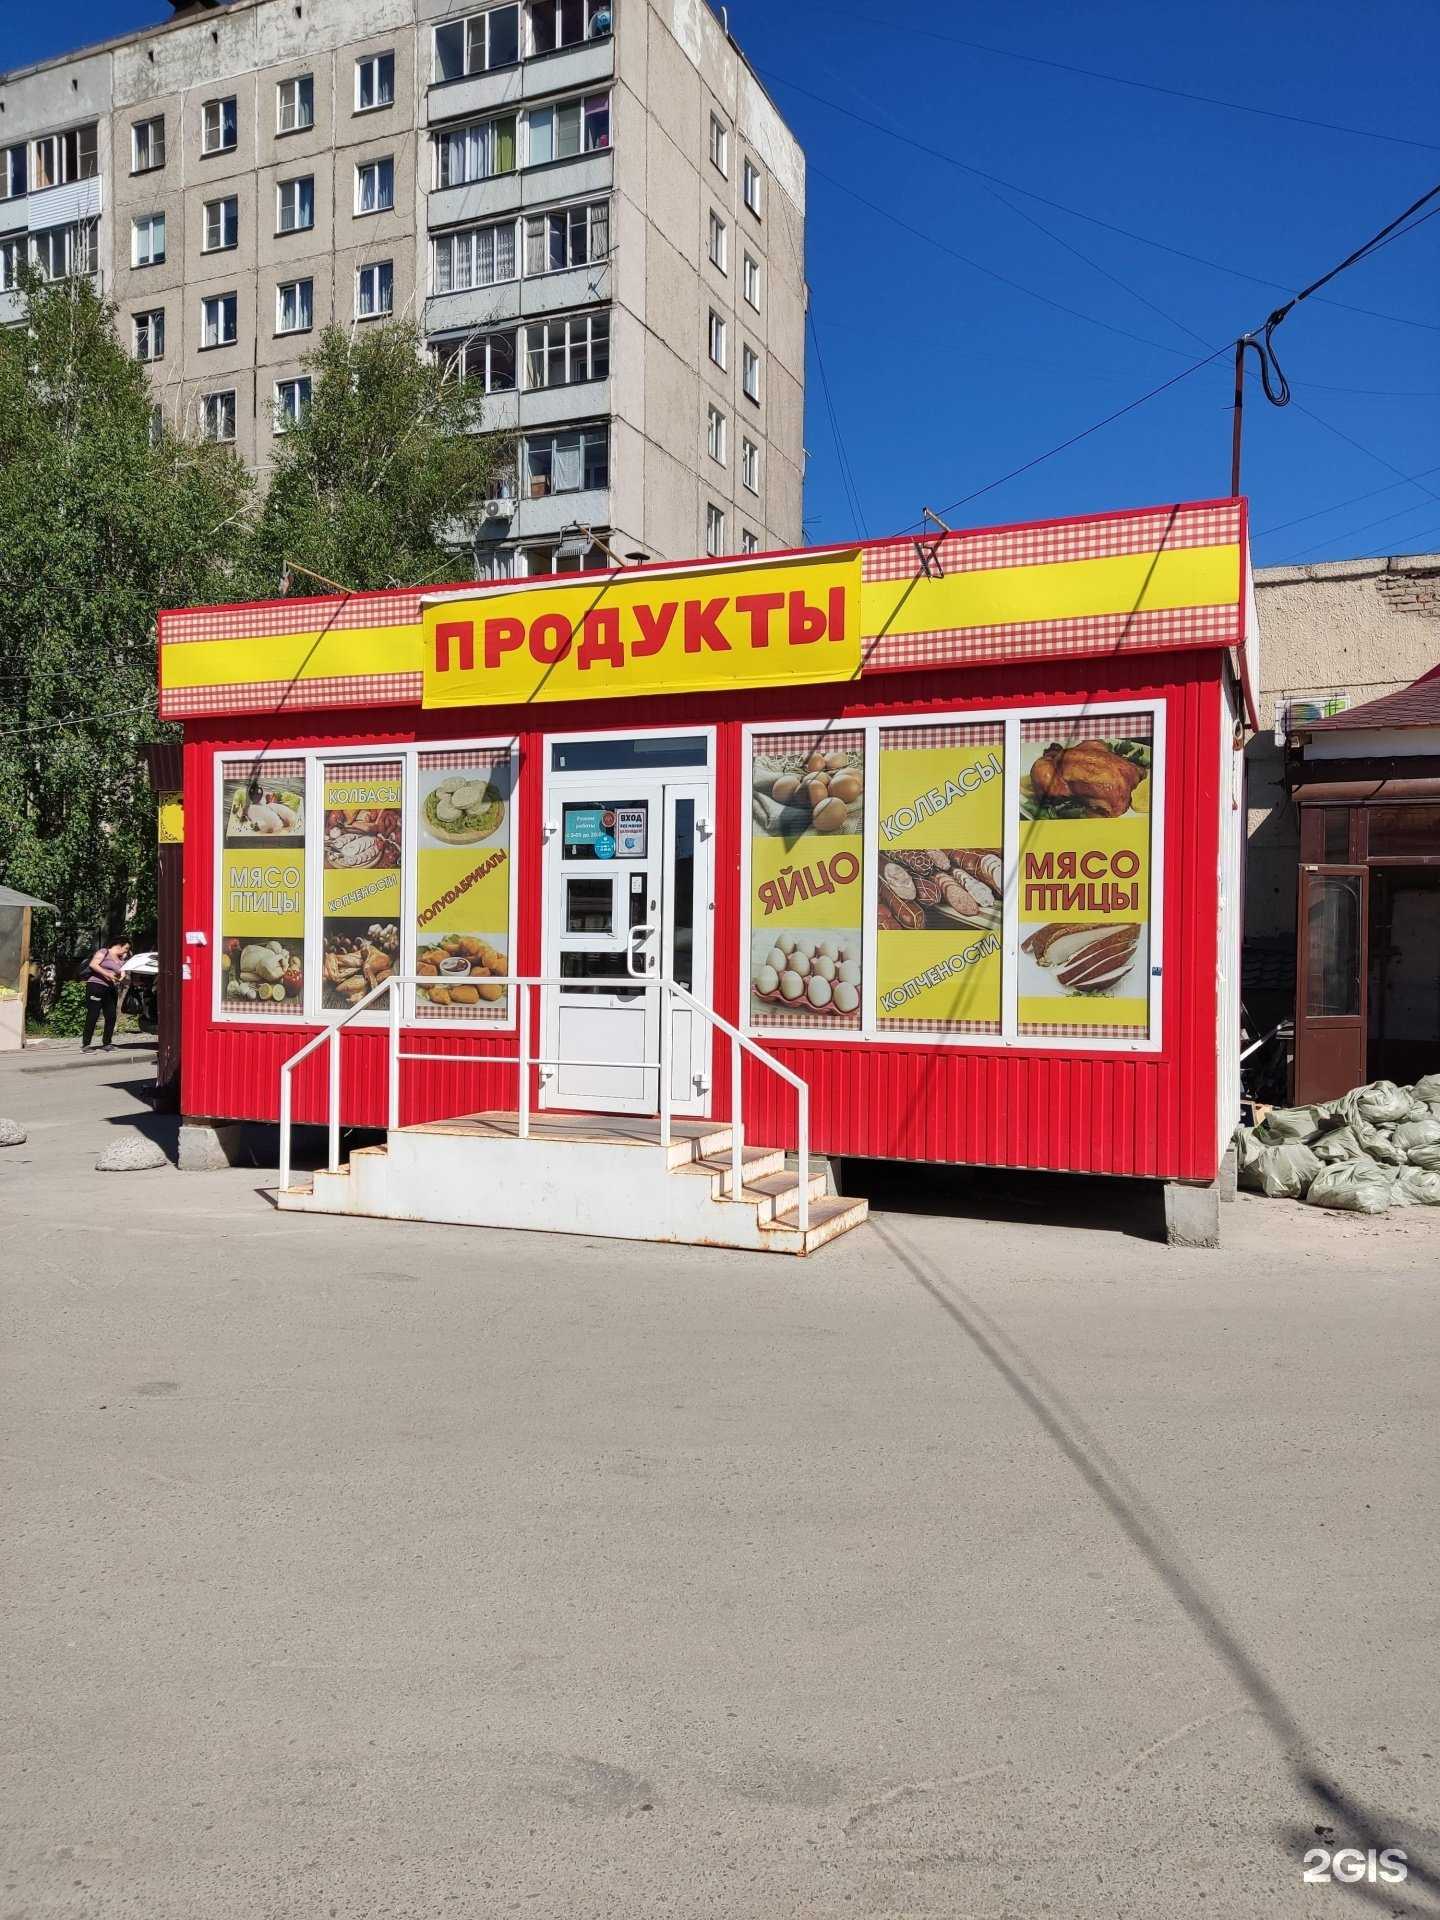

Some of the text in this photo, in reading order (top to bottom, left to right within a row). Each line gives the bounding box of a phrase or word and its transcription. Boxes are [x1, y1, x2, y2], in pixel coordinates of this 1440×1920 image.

[435, 586, 846, 672] ПРОДУКТЫ
[328, 787, 400, 804] КОЛБАСЫ
[880, 753, 1003, 842] КОЛБАСЫ
[620, 814, 642, 822] ВХОД
[229, 866, 300, 889] МЯСО
[1025, 850, 1141, 880] МЯСО
[328, 874, 398, 913] КОПЧЕНОСТИ
[416, 848, 507, 929] ПОЛУФАБРИКАТЫ
[757, 851, 860, 916] ЯЙЦО
[1025, 882, 1140, 914] ПТИЦЫ
[229, 891, 300, 917] ПТИЦЫ
[880, 934, 1001, 1012] КОПЧЕНОСТИ
